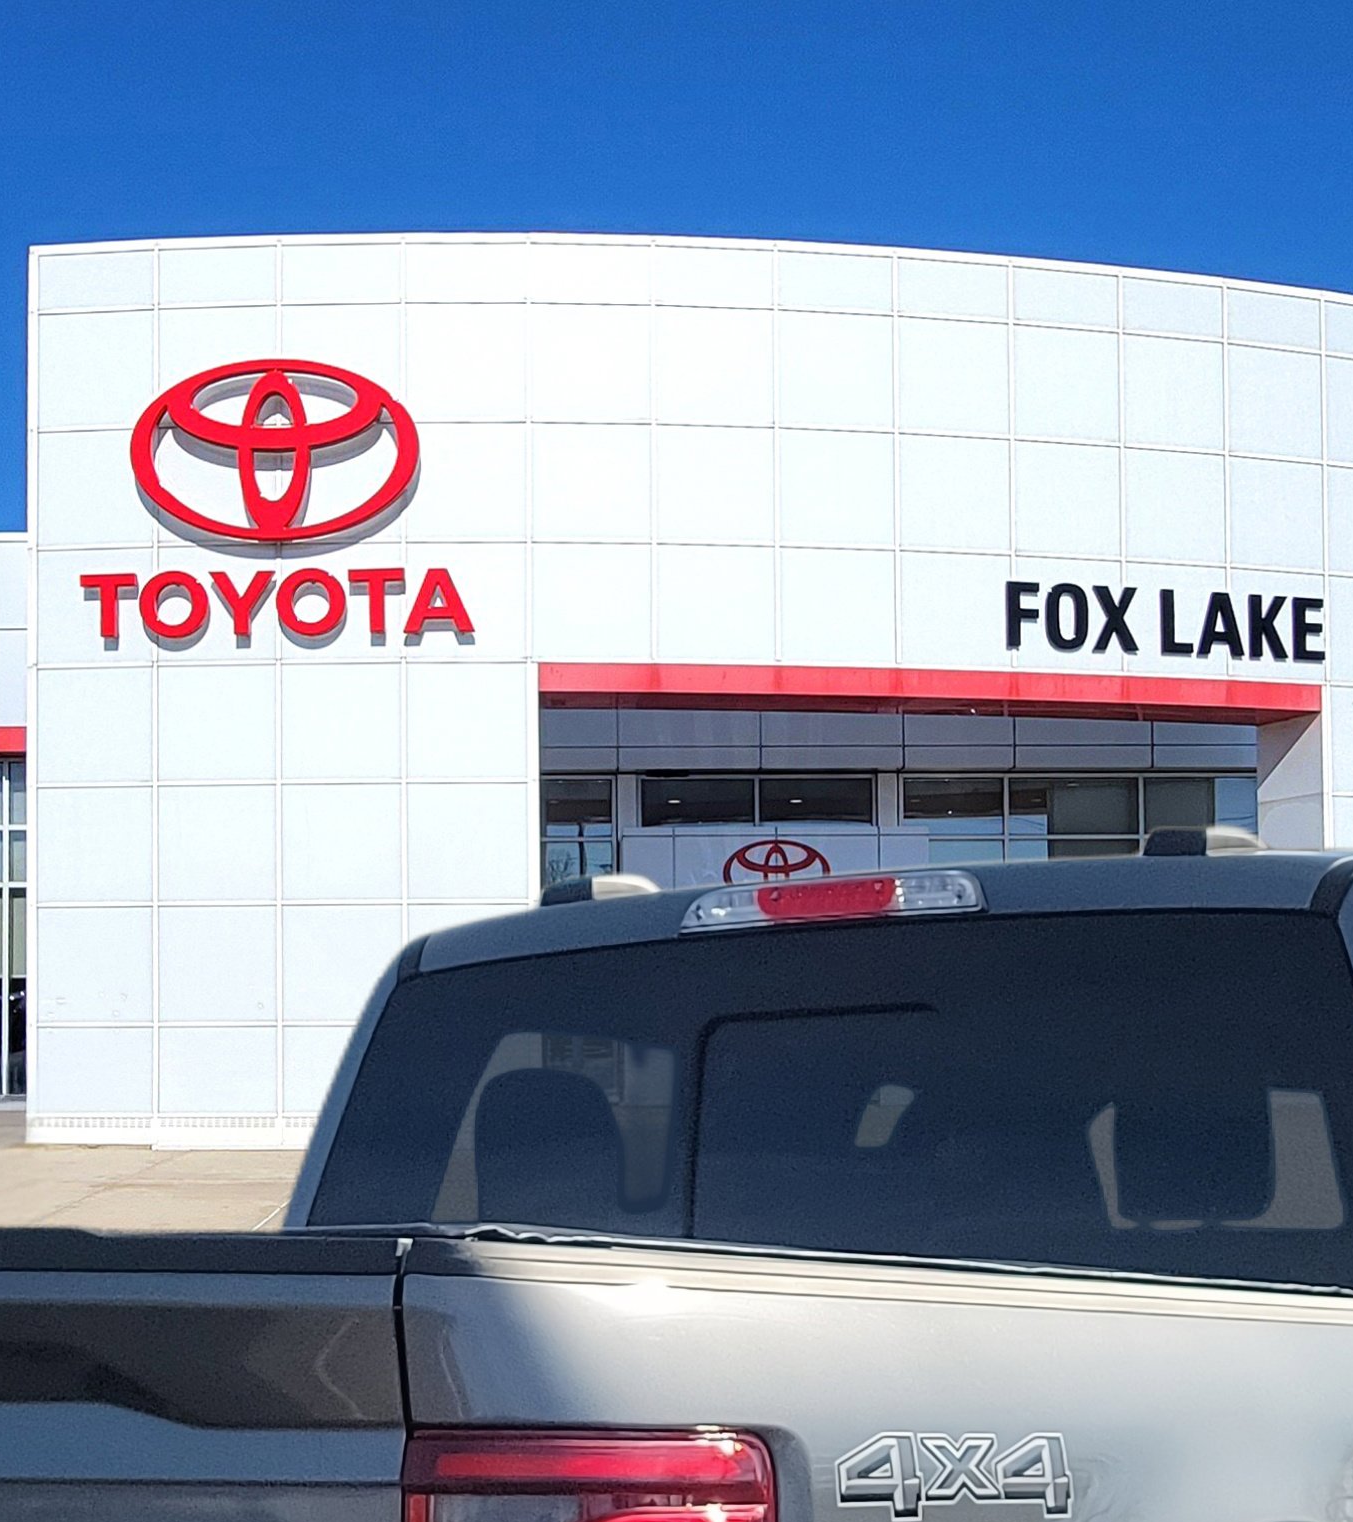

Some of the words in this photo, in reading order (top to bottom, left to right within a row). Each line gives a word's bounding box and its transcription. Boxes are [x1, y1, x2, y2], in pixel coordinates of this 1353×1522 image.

[79, 567, 476, 641] TOYOTA
[1005, 580, 1140, 653] FOX
[1159, 588, 1326, 661] LAKE
